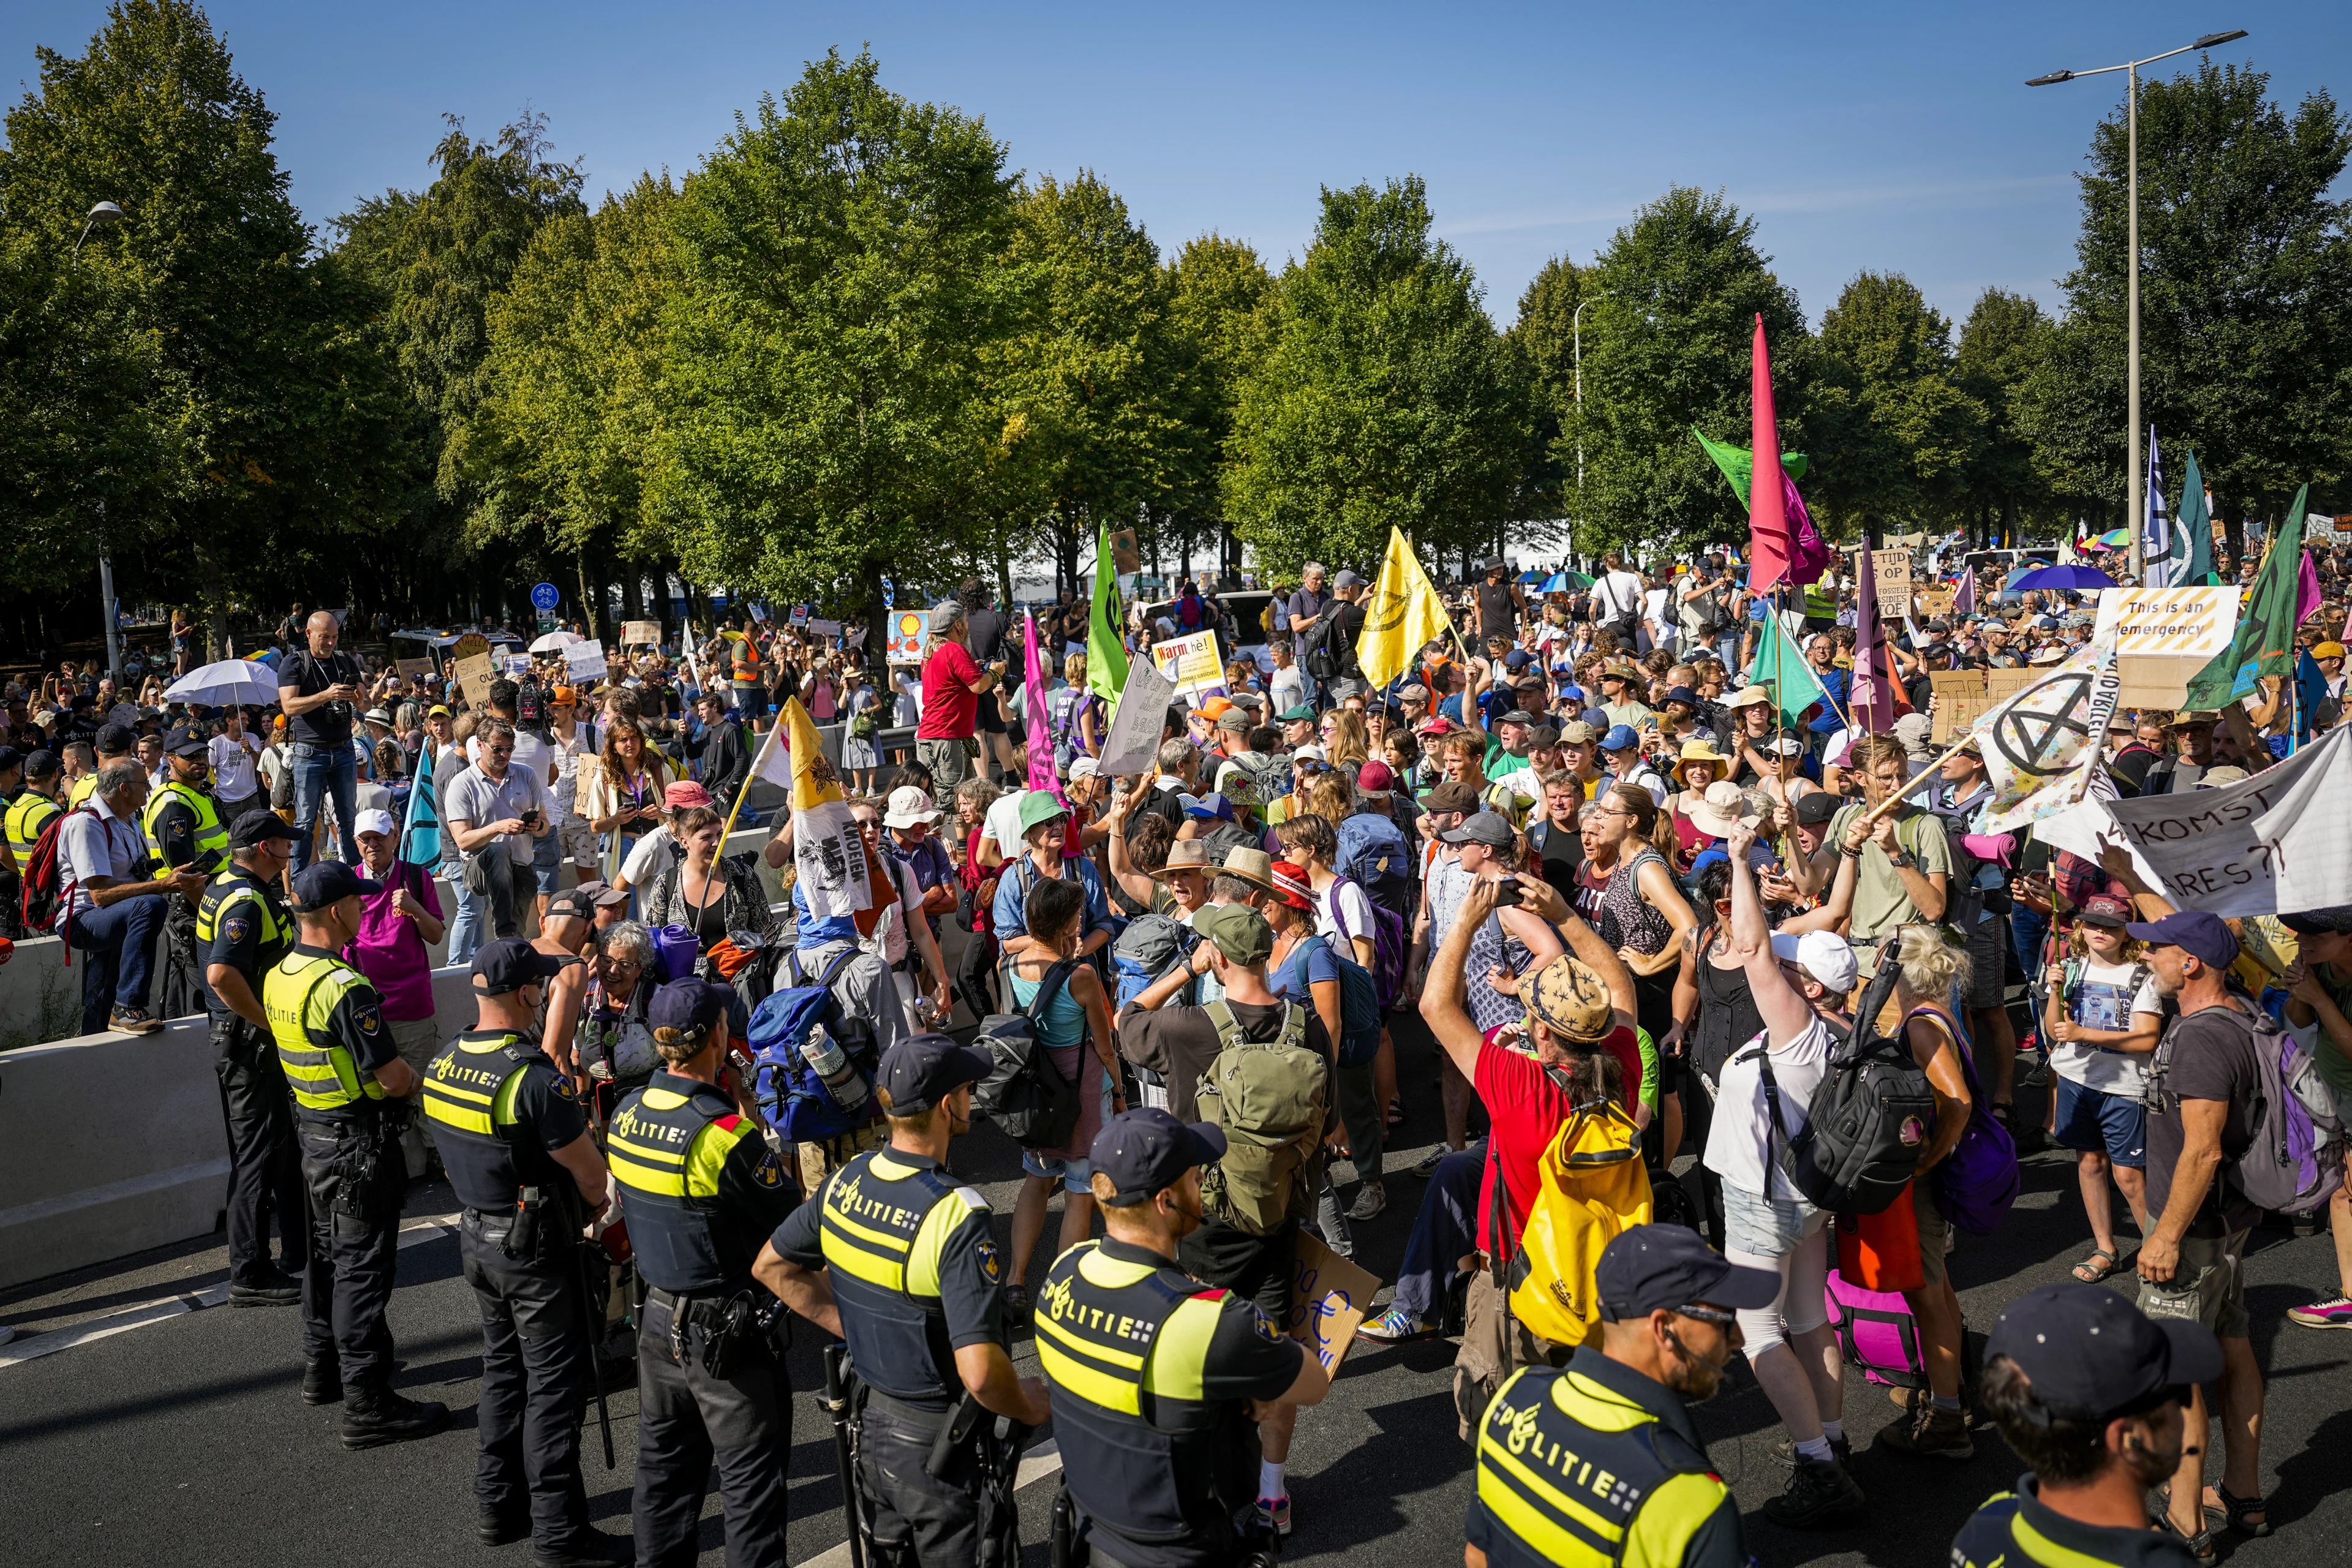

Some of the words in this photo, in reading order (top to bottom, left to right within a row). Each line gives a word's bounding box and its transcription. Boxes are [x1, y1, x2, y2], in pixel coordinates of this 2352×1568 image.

[1882, 552, 1906, 566] TIJD
[1885, 567, 1903, 579] OP
[1879, 587, 1910, 595] FOSSIELE
[1877, 595, 1907, 604] BSIDIES
[1879, 603, 1903, 616] TOP
[2128, 601, 2159, 614] This
[2166, 600, 2179, 612] is
[2184, 603, 2204, 613] an
[2120, 624, 2206, 639] emergency
[1157, 641, 1190, 661] Warm,
[65, 729, 97, 741] POLITI
[228, 748, 243, 757] TEACH
[579, 758, 589, 777] Ik
[1575, 887, 1605, 911] ACT
[2255, 938, 2264, 952] B
[355, 1006, 377, 1019] POLITIE
[433, 1051, 491, 1085] POLITIE
[615, 1104, 678, 1143] POLITIE
[755, 1152, 772, 1177] POLITIE
[839, 1175, 906, 1227] POLITIE
[978, 1245, 998, 1256] POLIT
[1044, 1275, 1134, 1338] POLITIE
[2144, 1305, 2168, 1315] Ritchie
[2167, 1308, 2192, 1321] Denim
[1499, 1402, 1616, 1499] POLITIE
